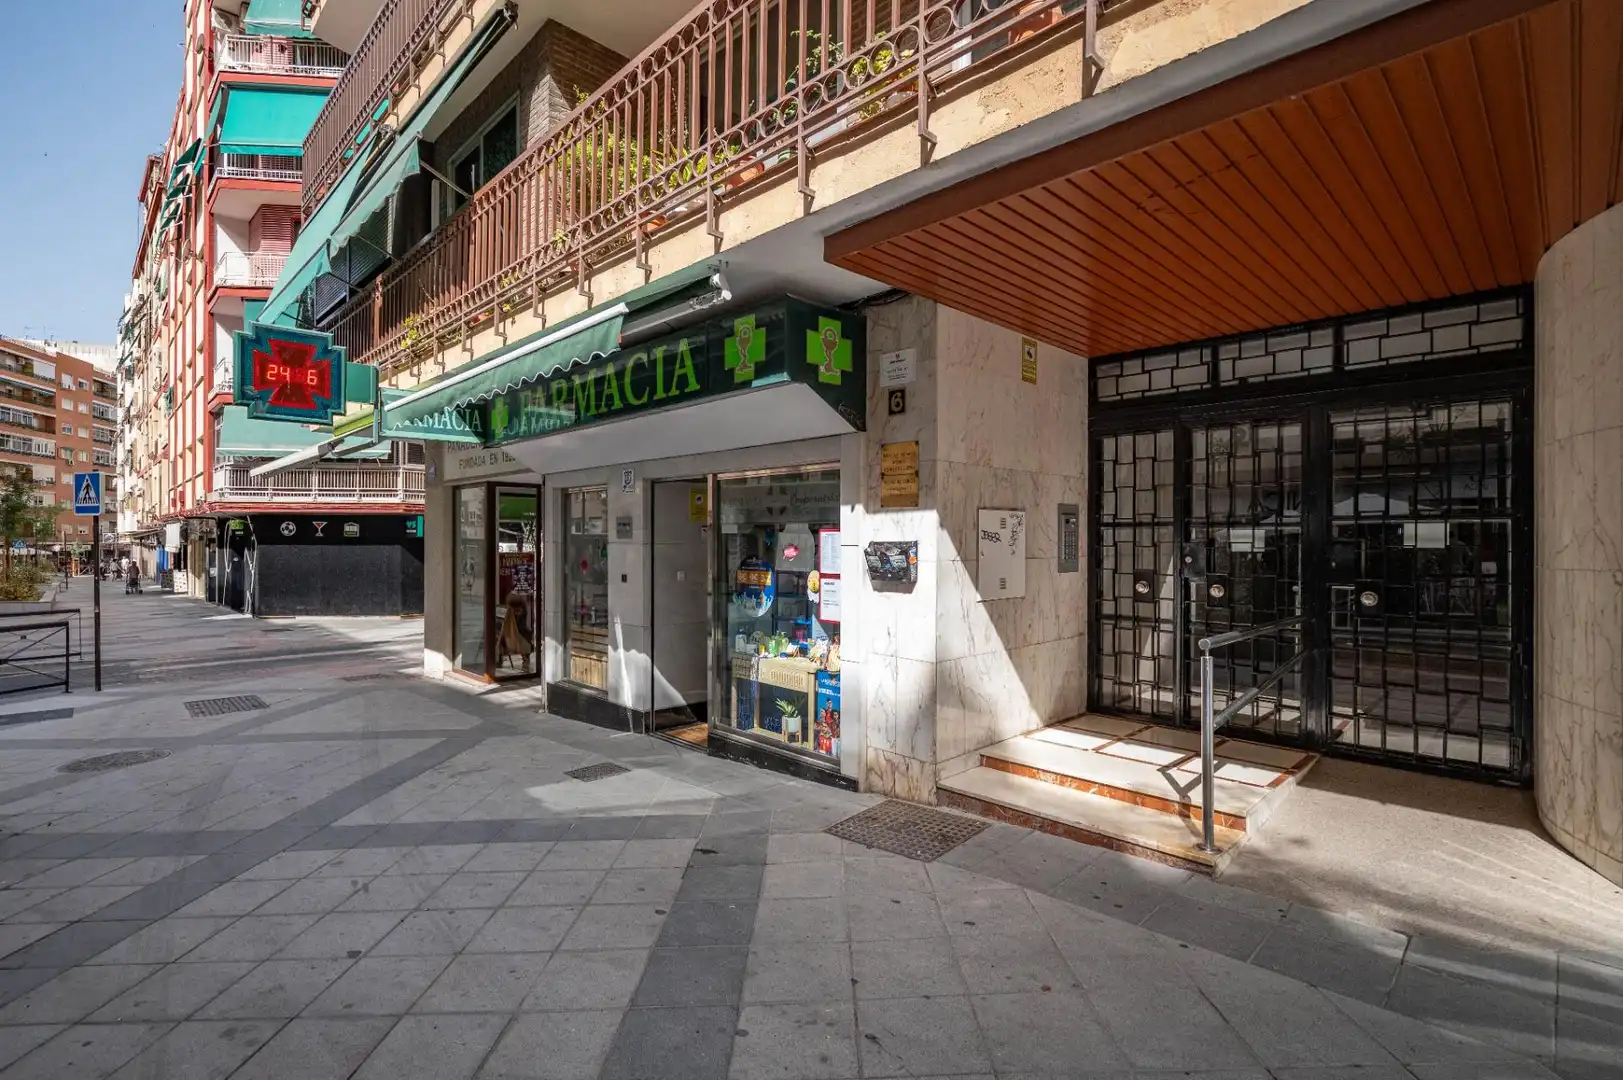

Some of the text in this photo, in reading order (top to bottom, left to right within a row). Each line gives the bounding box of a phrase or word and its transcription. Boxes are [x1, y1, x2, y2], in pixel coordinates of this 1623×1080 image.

[266, 364, 318, 386] 24 6
[890, 391, 903, 412] 6
[459, 455, 486, 470] FUNDADA
[489, 452, 498, 465] EN
